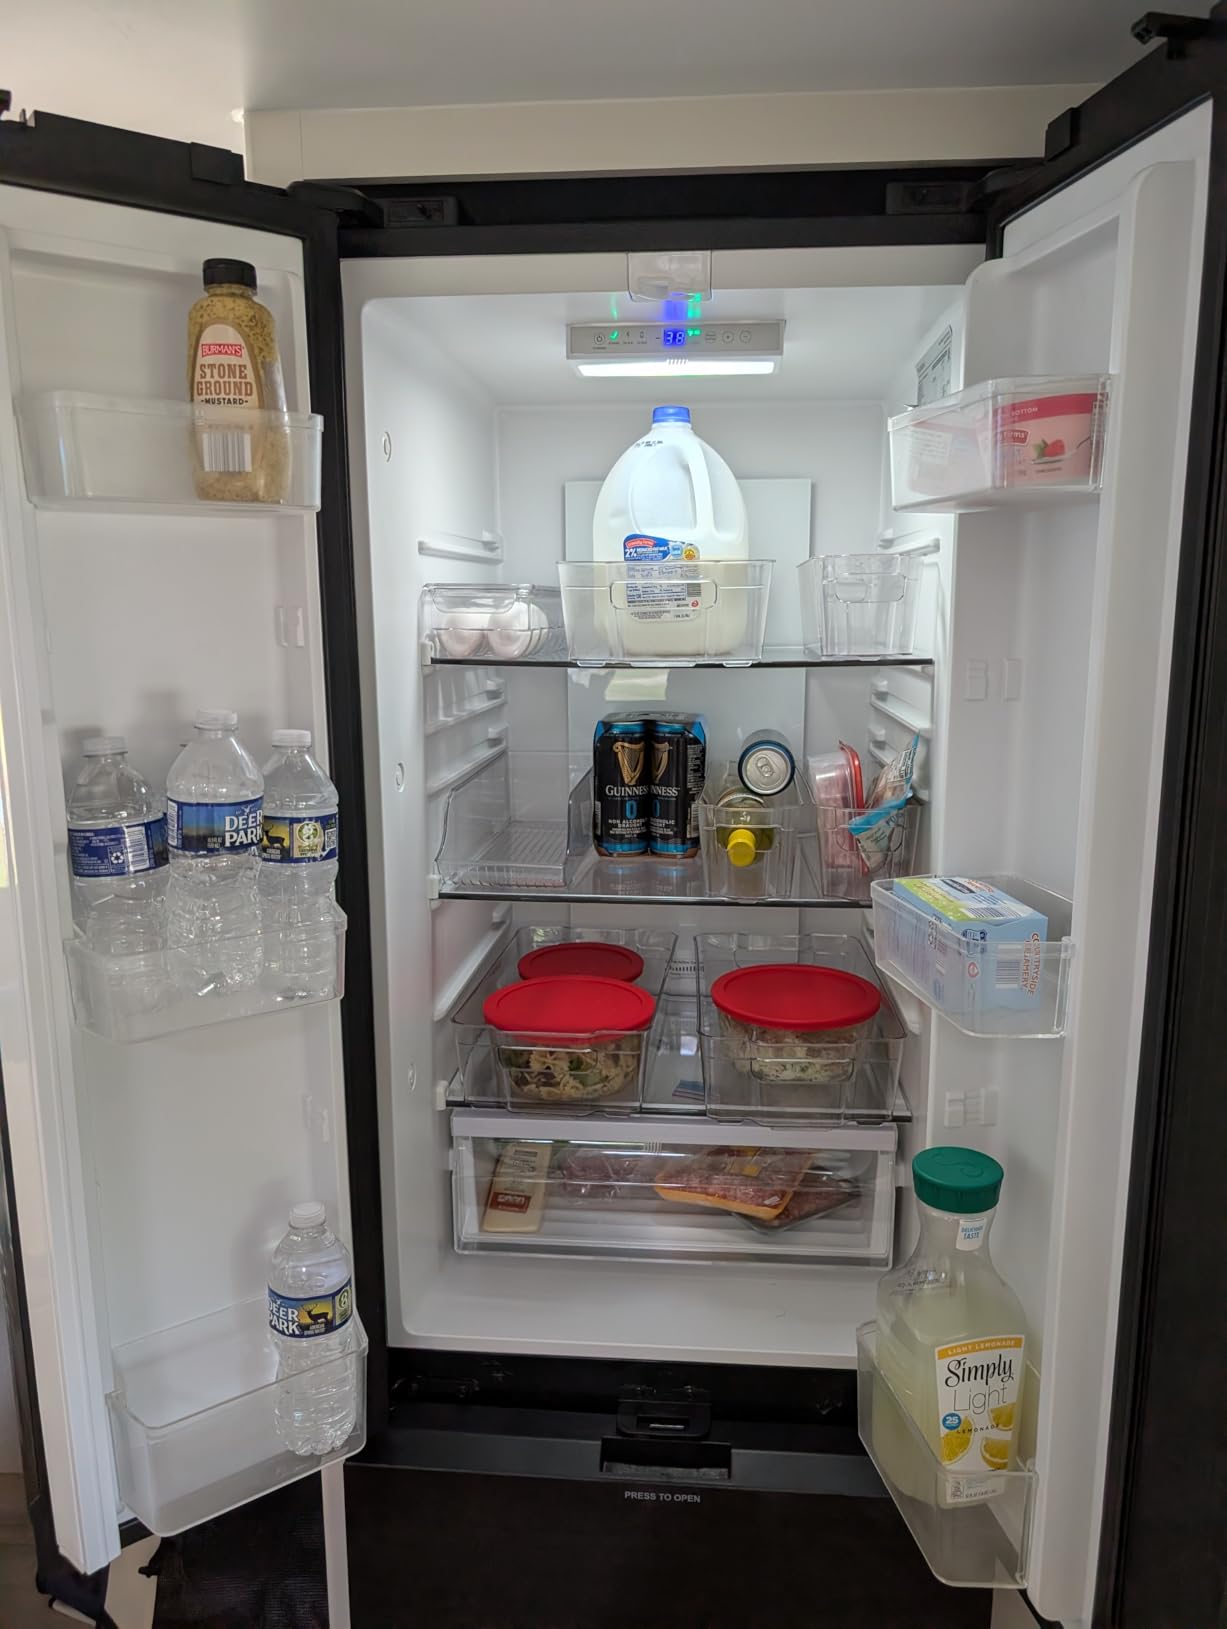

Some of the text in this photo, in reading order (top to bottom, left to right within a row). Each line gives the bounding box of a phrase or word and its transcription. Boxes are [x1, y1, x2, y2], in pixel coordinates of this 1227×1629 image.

[665, 331, 685, 344] 38
[202, 345, 242, 356] BURMAN'S
[200, 363, 248, 379] STONE
[196, 381, 253, 396] GROUND
[625, 549, 637, 557] 2%
[625, 799, 637, 819] 0
[225, 810, 263, 831] DEER
[224, 825, 263, 847] PARK
[948, 1346, 972, 1355] LIGHT
[945, 1354, 1014, 1387] Simply
[953, 1384, 1007, 1415] Light
[945, 1416, 959, 1424] 25
[624, 1491, 701, 1503] PRESS TO OPEN
